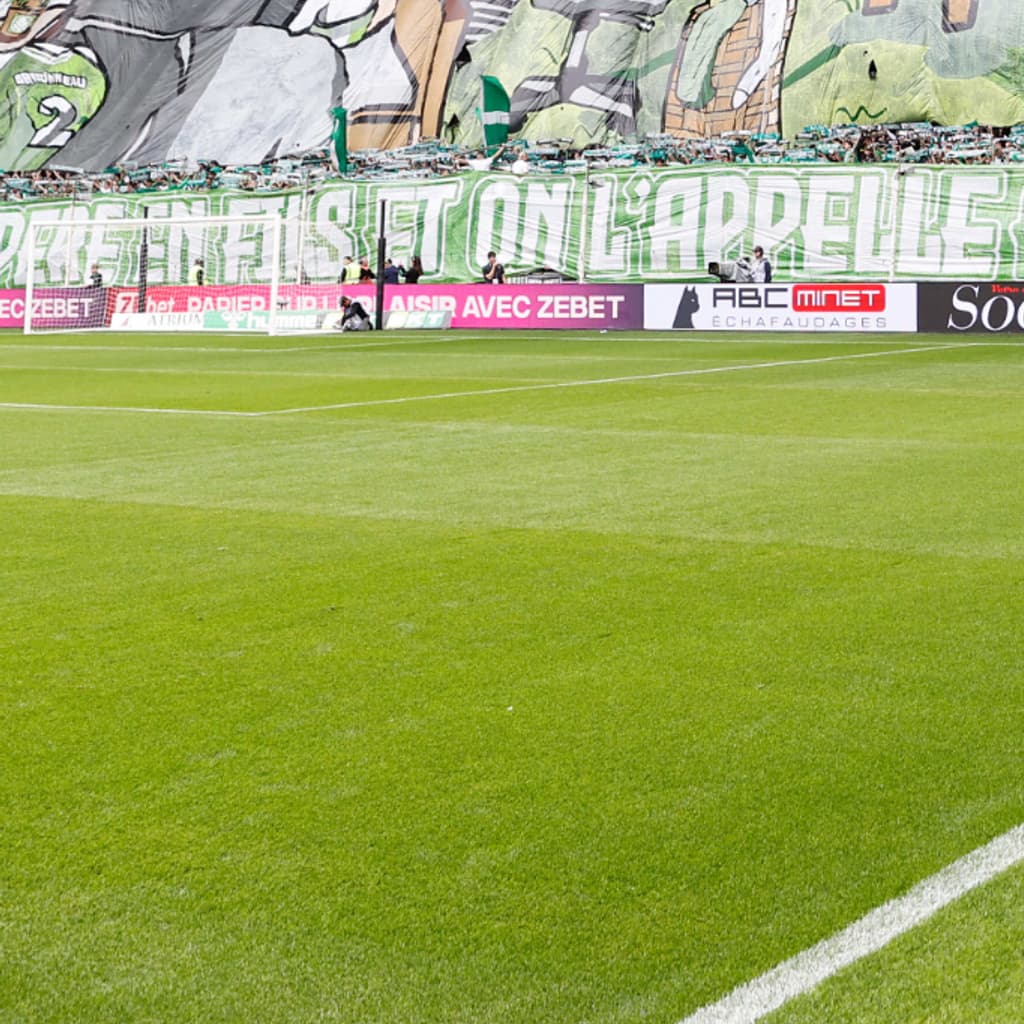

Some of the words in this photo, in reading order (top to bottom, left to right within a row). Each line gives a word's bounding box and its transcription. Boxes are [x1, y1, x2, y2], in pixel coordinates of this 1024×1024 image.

[28, 94, 77, 147] 2
[374, 183, 459, 276] ET
[475, 179, 571, 275] ON
[588, 173, 1000, 275] L'APPELLE
[32, 298, 93, 318] ZEBET
[462, 295, 531, 319] AVEC
[537, 295, 625, 320] ZEBET
[712, 287, 788, 309] ABC
